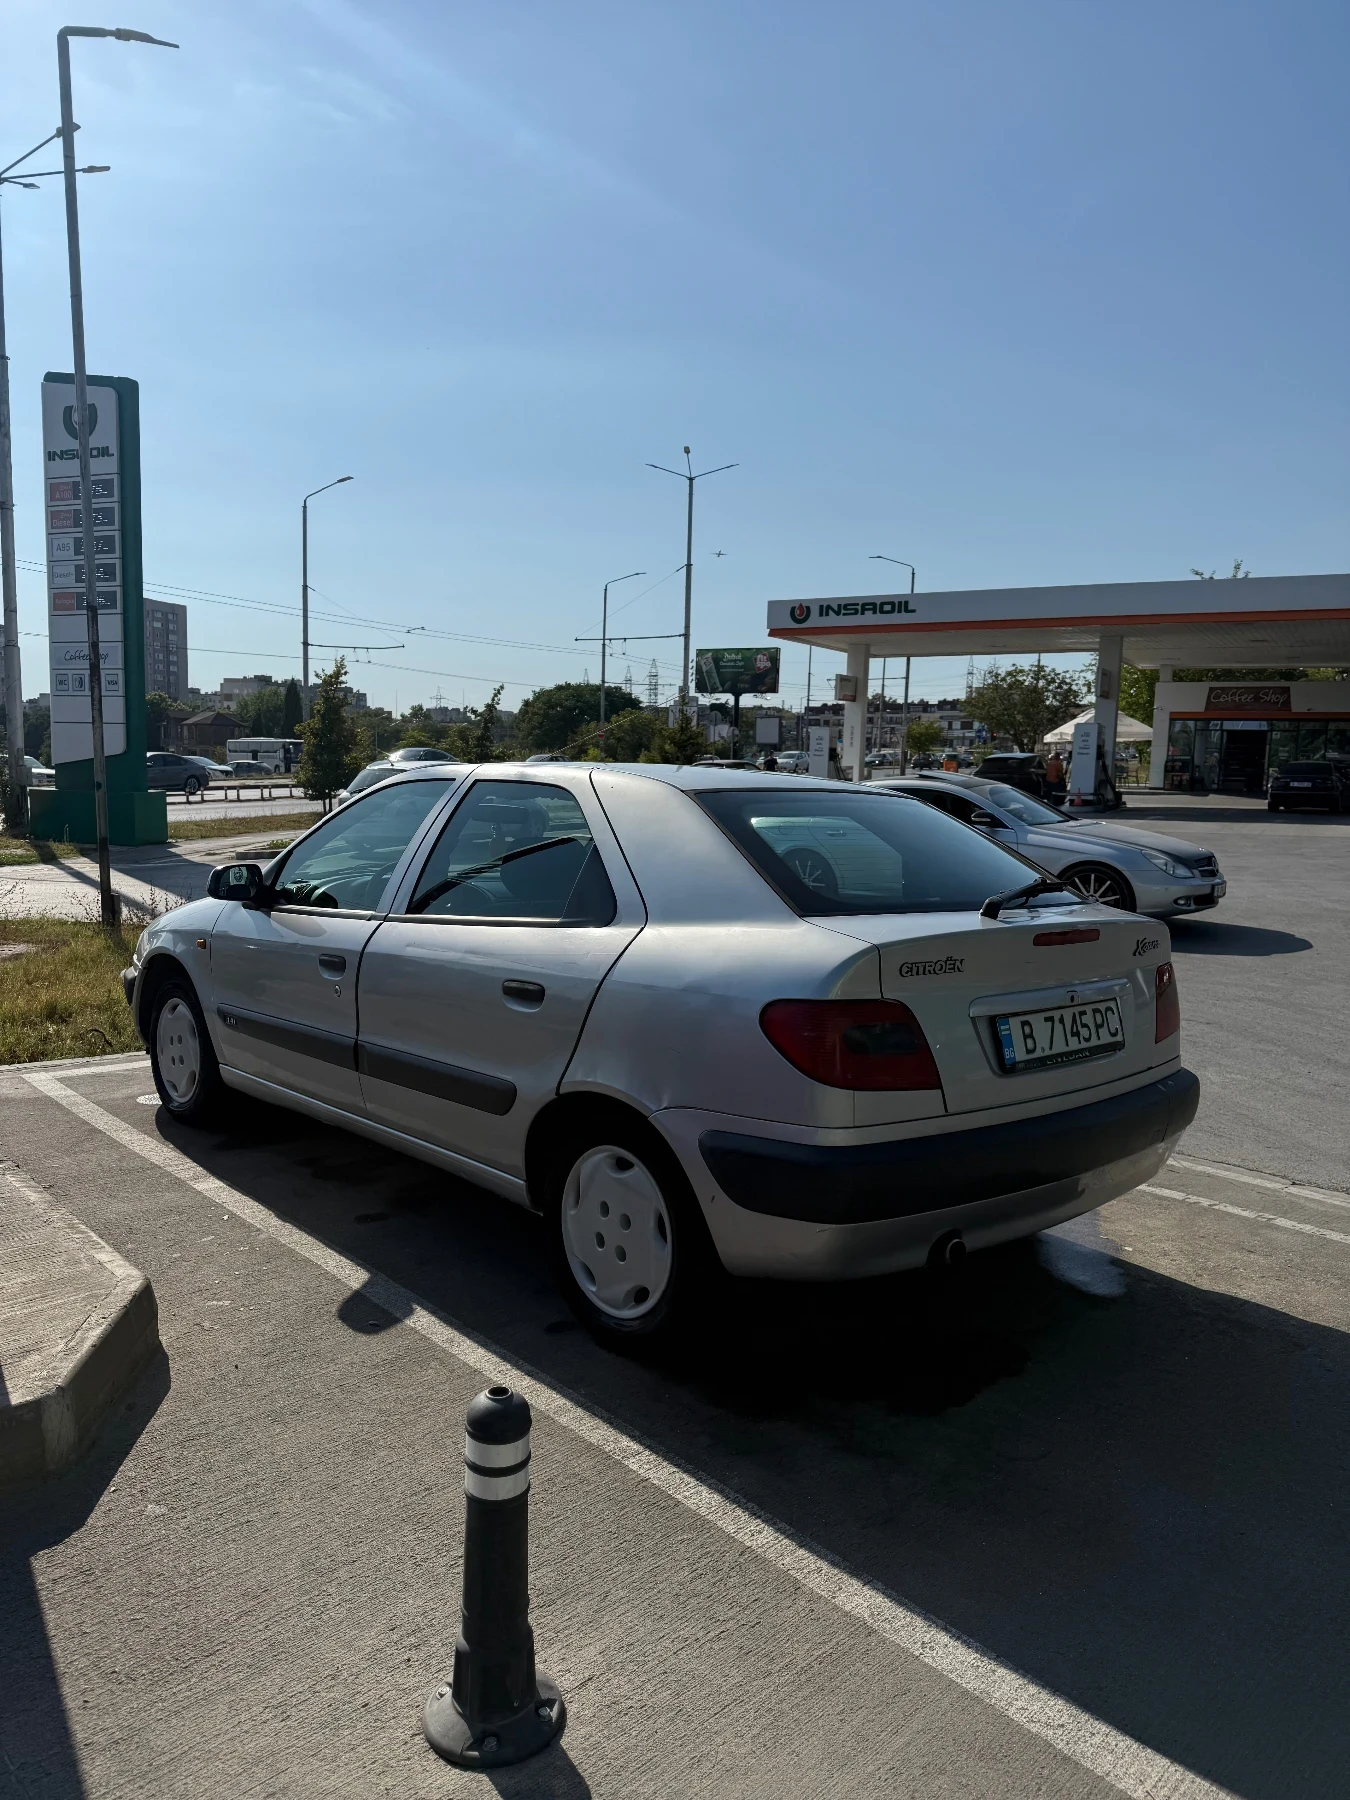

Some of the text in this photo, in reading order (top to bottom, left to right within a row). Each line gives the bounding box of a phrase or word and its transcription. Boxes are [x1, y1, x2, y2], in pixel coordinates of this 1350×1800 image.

[47, 445, 115, 462] INSOIL
[55, 490, 72, 499] A100
[56, 542, 71, 552] A95
[818, 600, 917, 618] INSAOIL
[1210, 688, 1288, 708] Coffee Shop
[898, 956, 966, 978] CITROËN
[1004, 1047, 1016, 1059] BG
